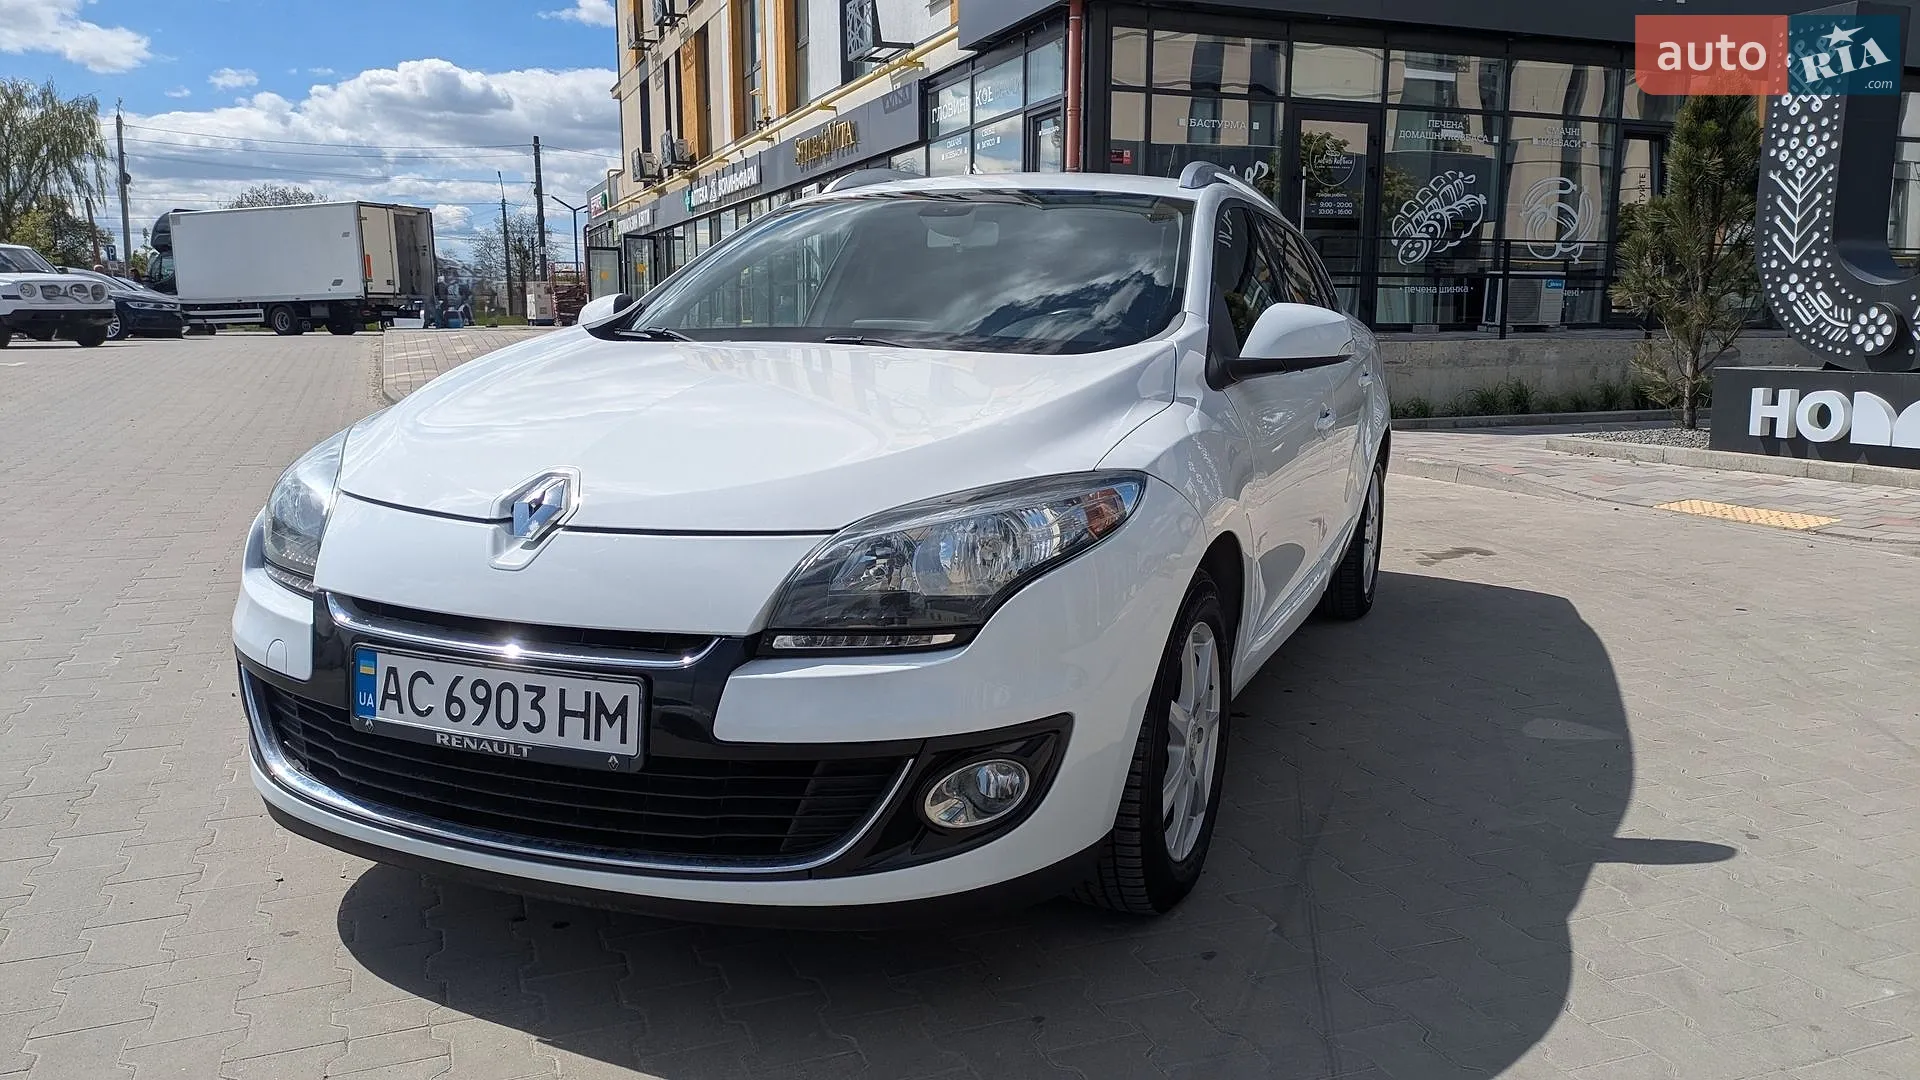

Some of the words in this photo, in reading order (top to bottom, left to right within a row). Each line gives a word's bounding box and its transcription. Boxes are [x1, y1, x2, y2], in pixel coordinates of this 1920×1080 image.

[1189, 118, 1247, 129] БАСТУРМА
[1428, 119, 1465, 129] ПЕЧЕНА
[1404, 286, 1438, 294] печена
[1438, 285, 1469, 294] шинка
[359, 692, 374, 708] UA
[379, 666, 435, 718] AC
[444, 675, 547, 734] 6903
[557, 687, 629, 745] HM
[435, 732, 534, 759] RENAULT
